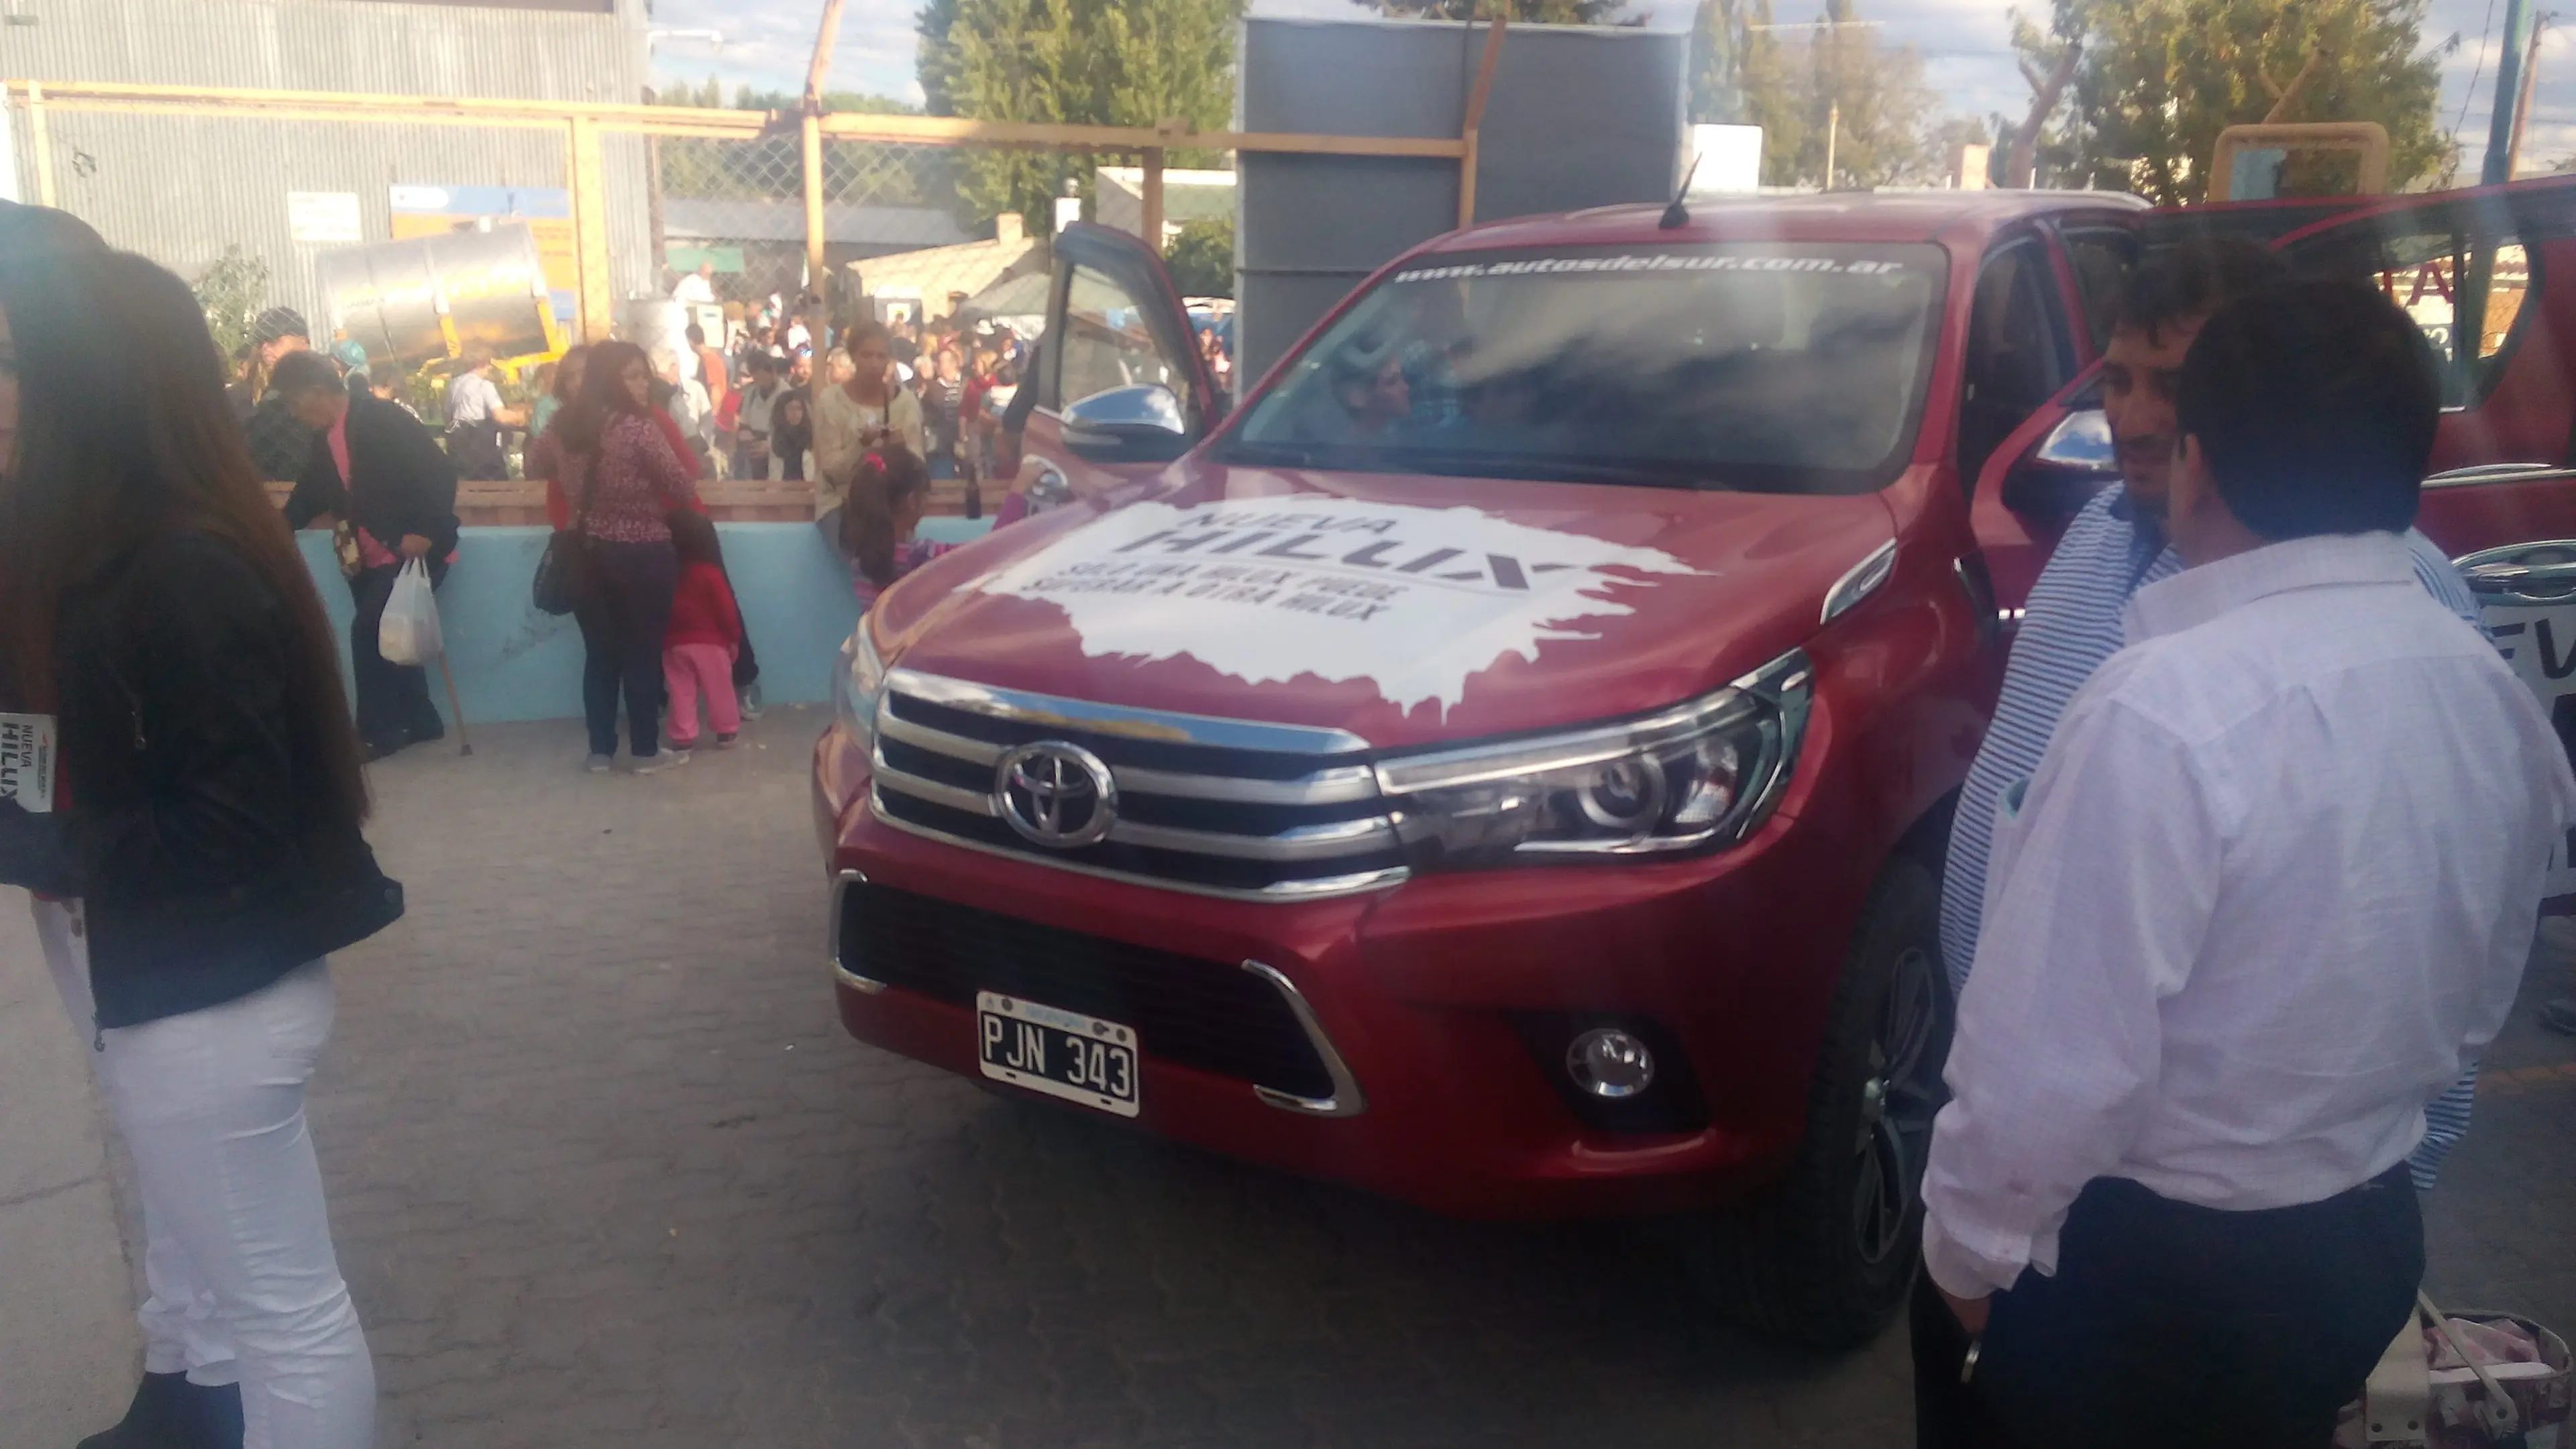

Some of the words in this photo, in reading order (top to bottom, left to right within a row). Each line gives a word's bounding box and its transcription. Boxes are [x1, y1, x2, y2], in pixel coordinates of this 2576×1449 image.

[1395, 254, 1904, 282] www.autosdelsur.com.ar
[1177, 513, 1397, 534] NUEVA
[1114, 529, 1572, 590] HILUX
[1197, 566, 1303, 586] HILUX
[1184, 582, 1279, 605] OTRA
[1276, 593, 1391, 622] HILUX
[21, 724, 34, 767] NUEVA
[983, 1013, 1045, 1073] PJN
[1065, 1036, 1131, 1098] 343
